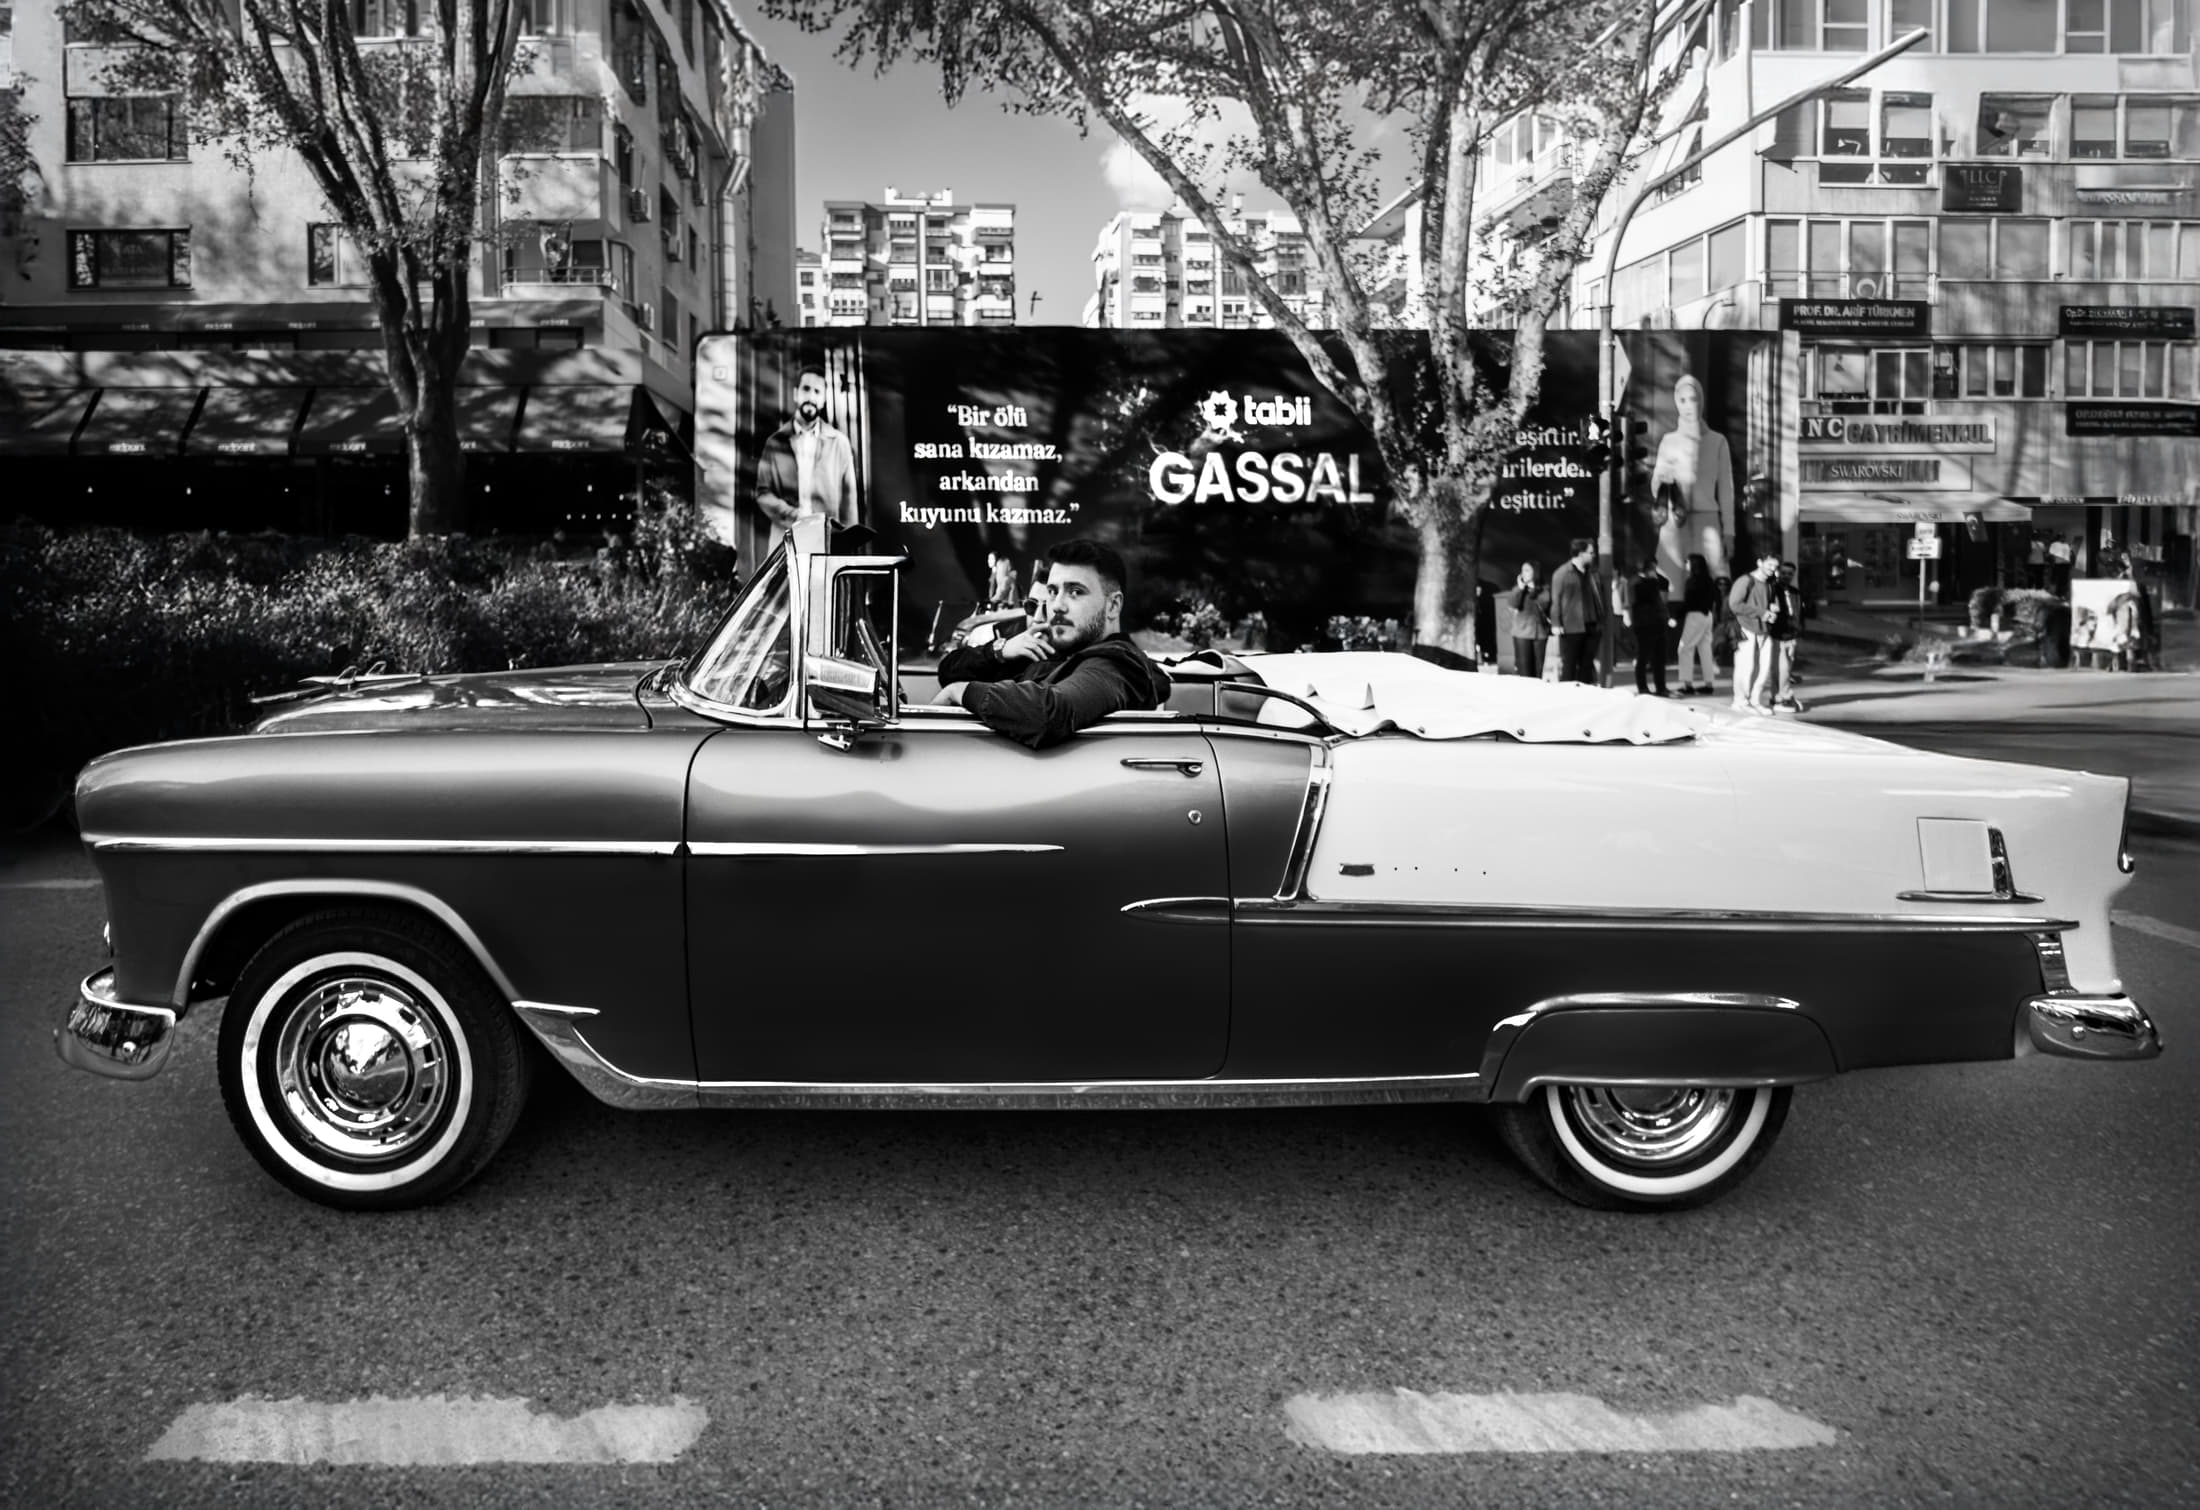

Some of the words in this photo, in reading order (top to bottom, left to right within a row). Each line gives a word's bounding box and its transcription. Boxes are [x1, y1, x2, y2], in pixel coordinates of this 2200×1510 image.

[1793, 305, 1822, 317] PROF.
[1823, 305, 1841, 317] DR.
[1868, 305, 1916, 318] TÜRKMEN
[947, 404, 991, 427] “Bir
[993, 404, 1028, 427] ölü
[1243, 395, 1311, 425] tabii
[1847, 420, 1994, 444] GAYRİMENKUL
[913, 441, 964, 459] sana
[968, 436, 1063, 463] kızamaz,
[939, 469, 1039, 492] arkandan
[1149, 451, 1376, 505] GASSAL
[1831, 465, 1903, 479] SWAROVSKI
[1500, 487, 1575, 514] eşittir.”
[899, 500, 981, 529] kuyunu
[986, 502, 1080, 524] kazmaz.”
